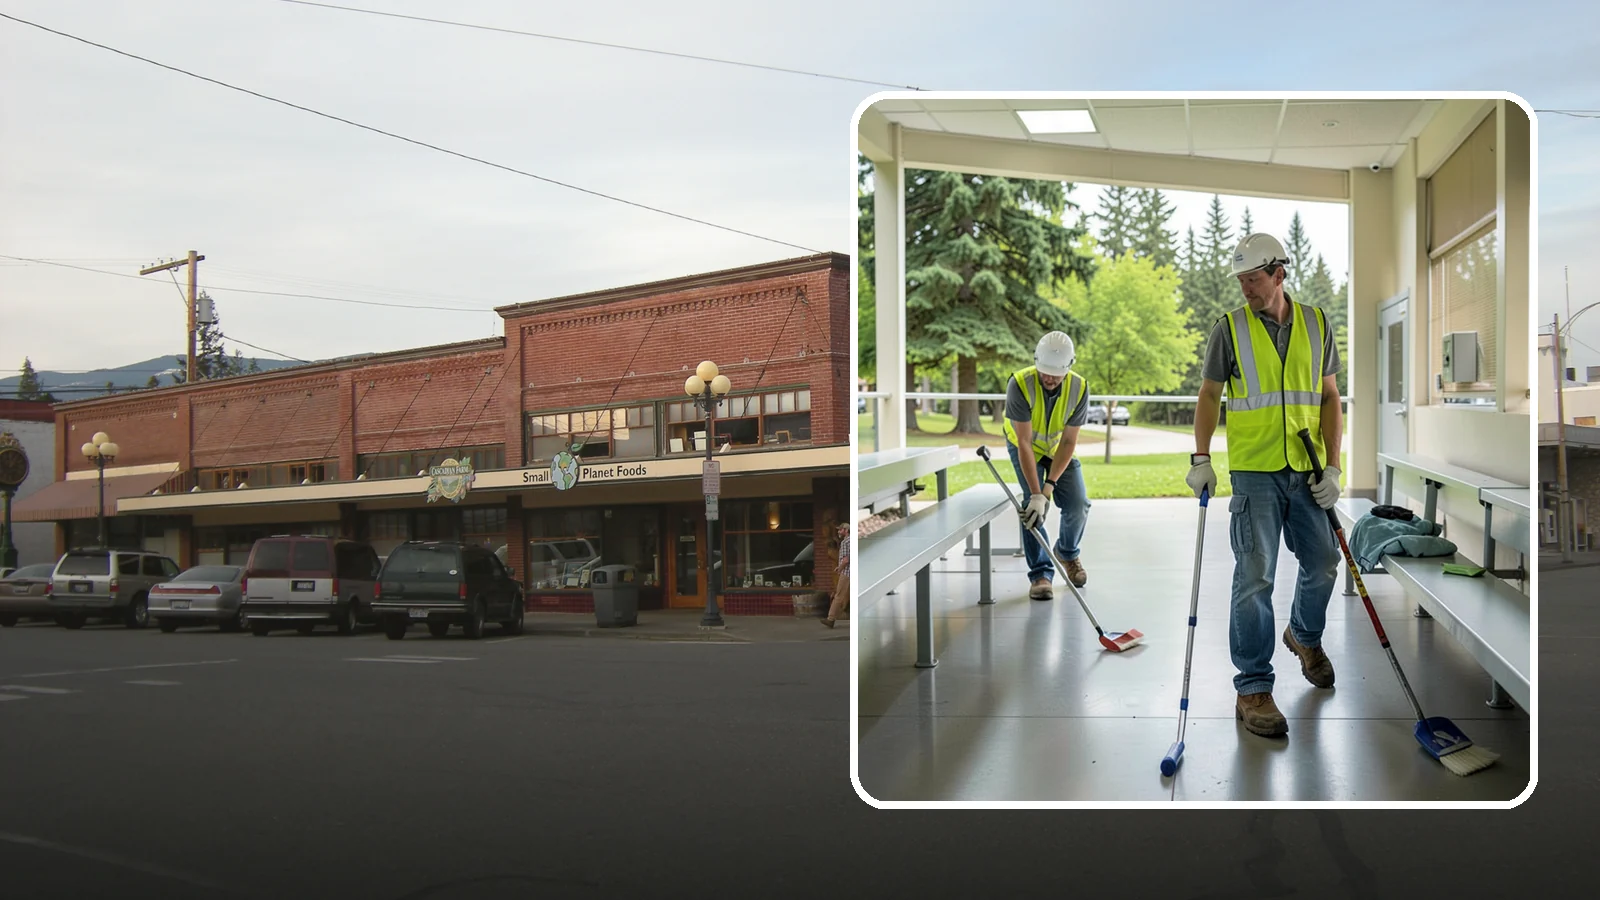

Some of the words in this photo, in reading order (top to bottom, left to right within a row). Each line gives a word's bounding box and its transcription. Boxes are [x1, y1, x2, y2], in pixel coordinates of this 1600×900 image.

[523, 471, 548, 483] Small
[583, 468, 613, 479] Planet
[617, 464, 647, 476] Foods
